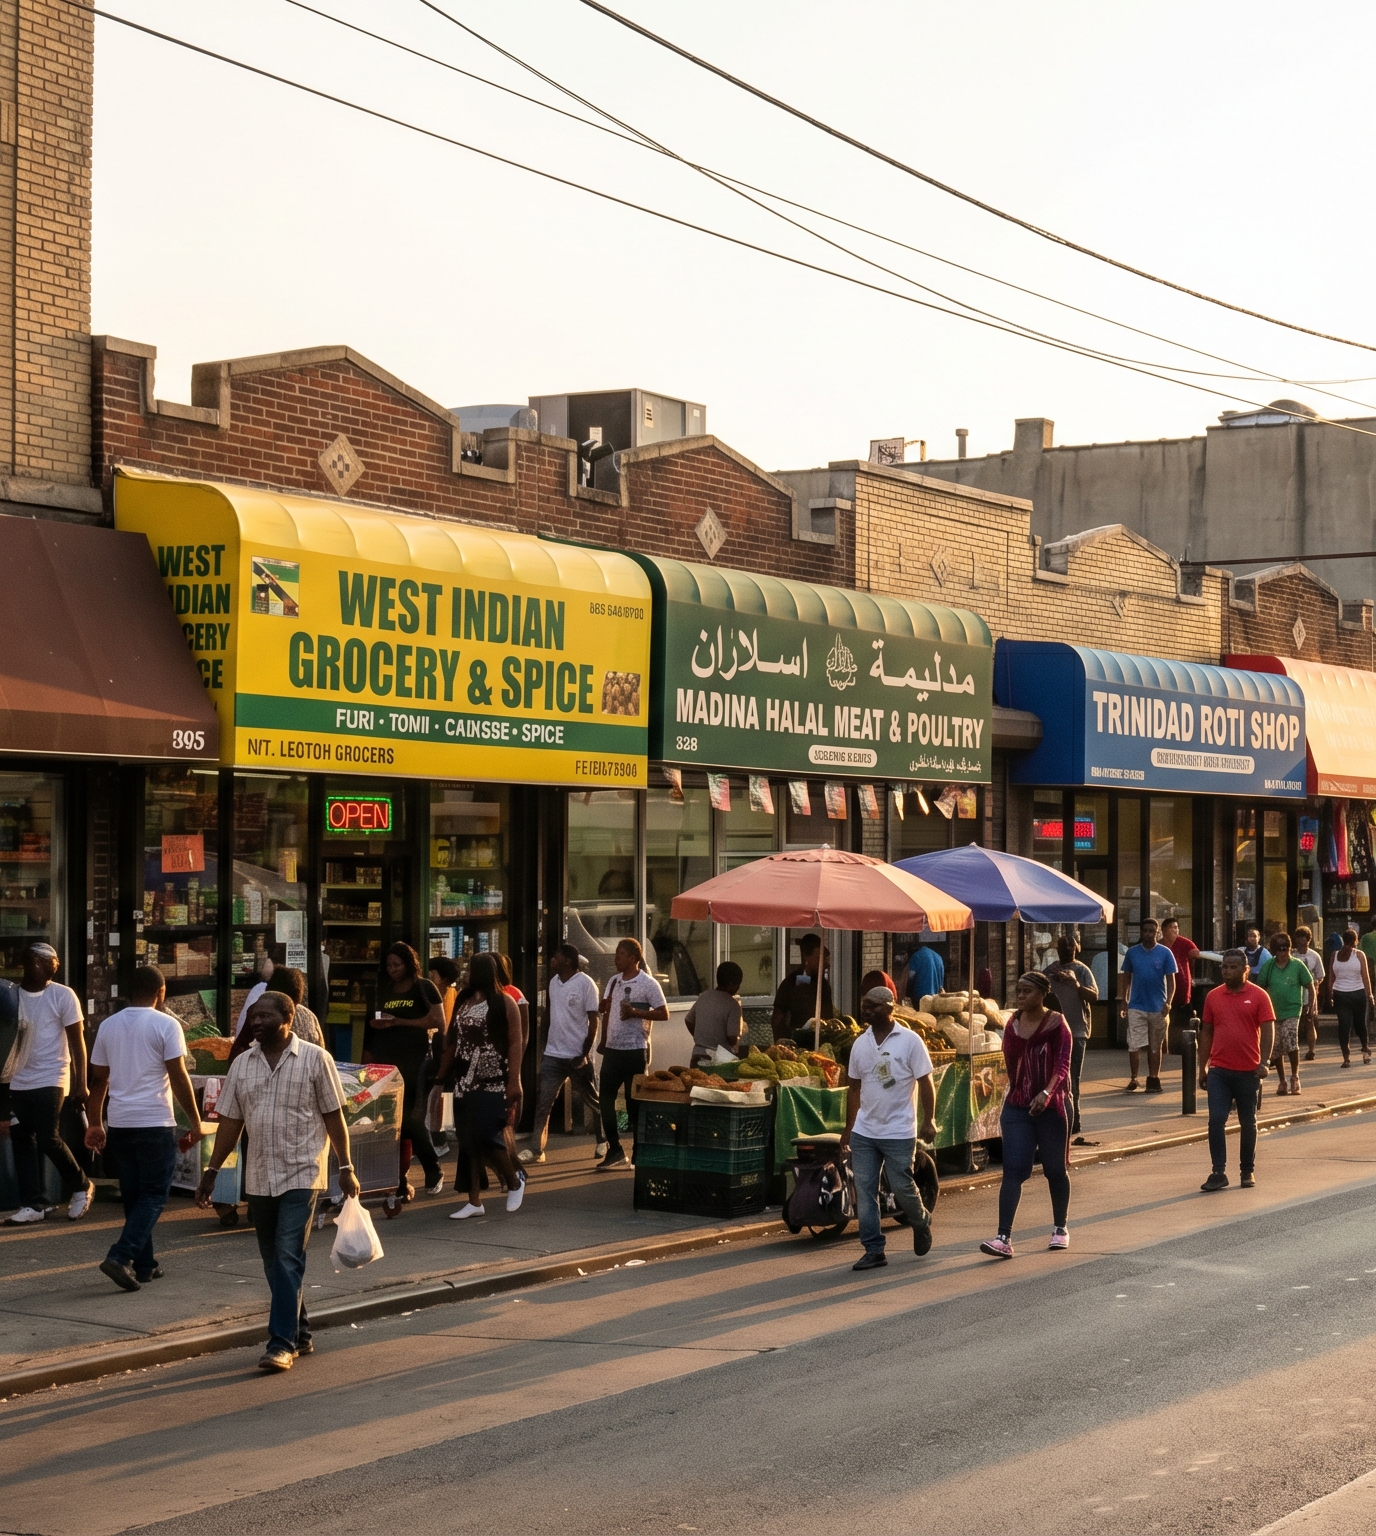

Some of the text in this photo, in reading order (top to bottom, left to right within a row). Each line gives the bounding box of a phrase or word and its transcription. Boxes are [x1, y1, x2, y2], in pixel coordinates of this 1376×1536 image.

[157, 544, 225, 577] WEST
[168, 583, 231, 614] DIAN
[338, 570, 565, 651] WEST INDIAN
[288, 631, 594, 714] GROCERY & SPICE
[336, 708, 374, 730] FURI
[521, 723, 564, 744] SPICE
[676, 688, 984, 749] MADINA HALAL MEAT & POULTRY
[1092, 690, 1195, 742] TRINIDAD
[1200, 704, 1245, 748] ROTI
[1250, 710, 1300, 752] SHOP
[280, 740, 331, 760] LEOTOH
[335, 744, 395, 765] GROCERS
[329, 802, 389, 829] OPEN
